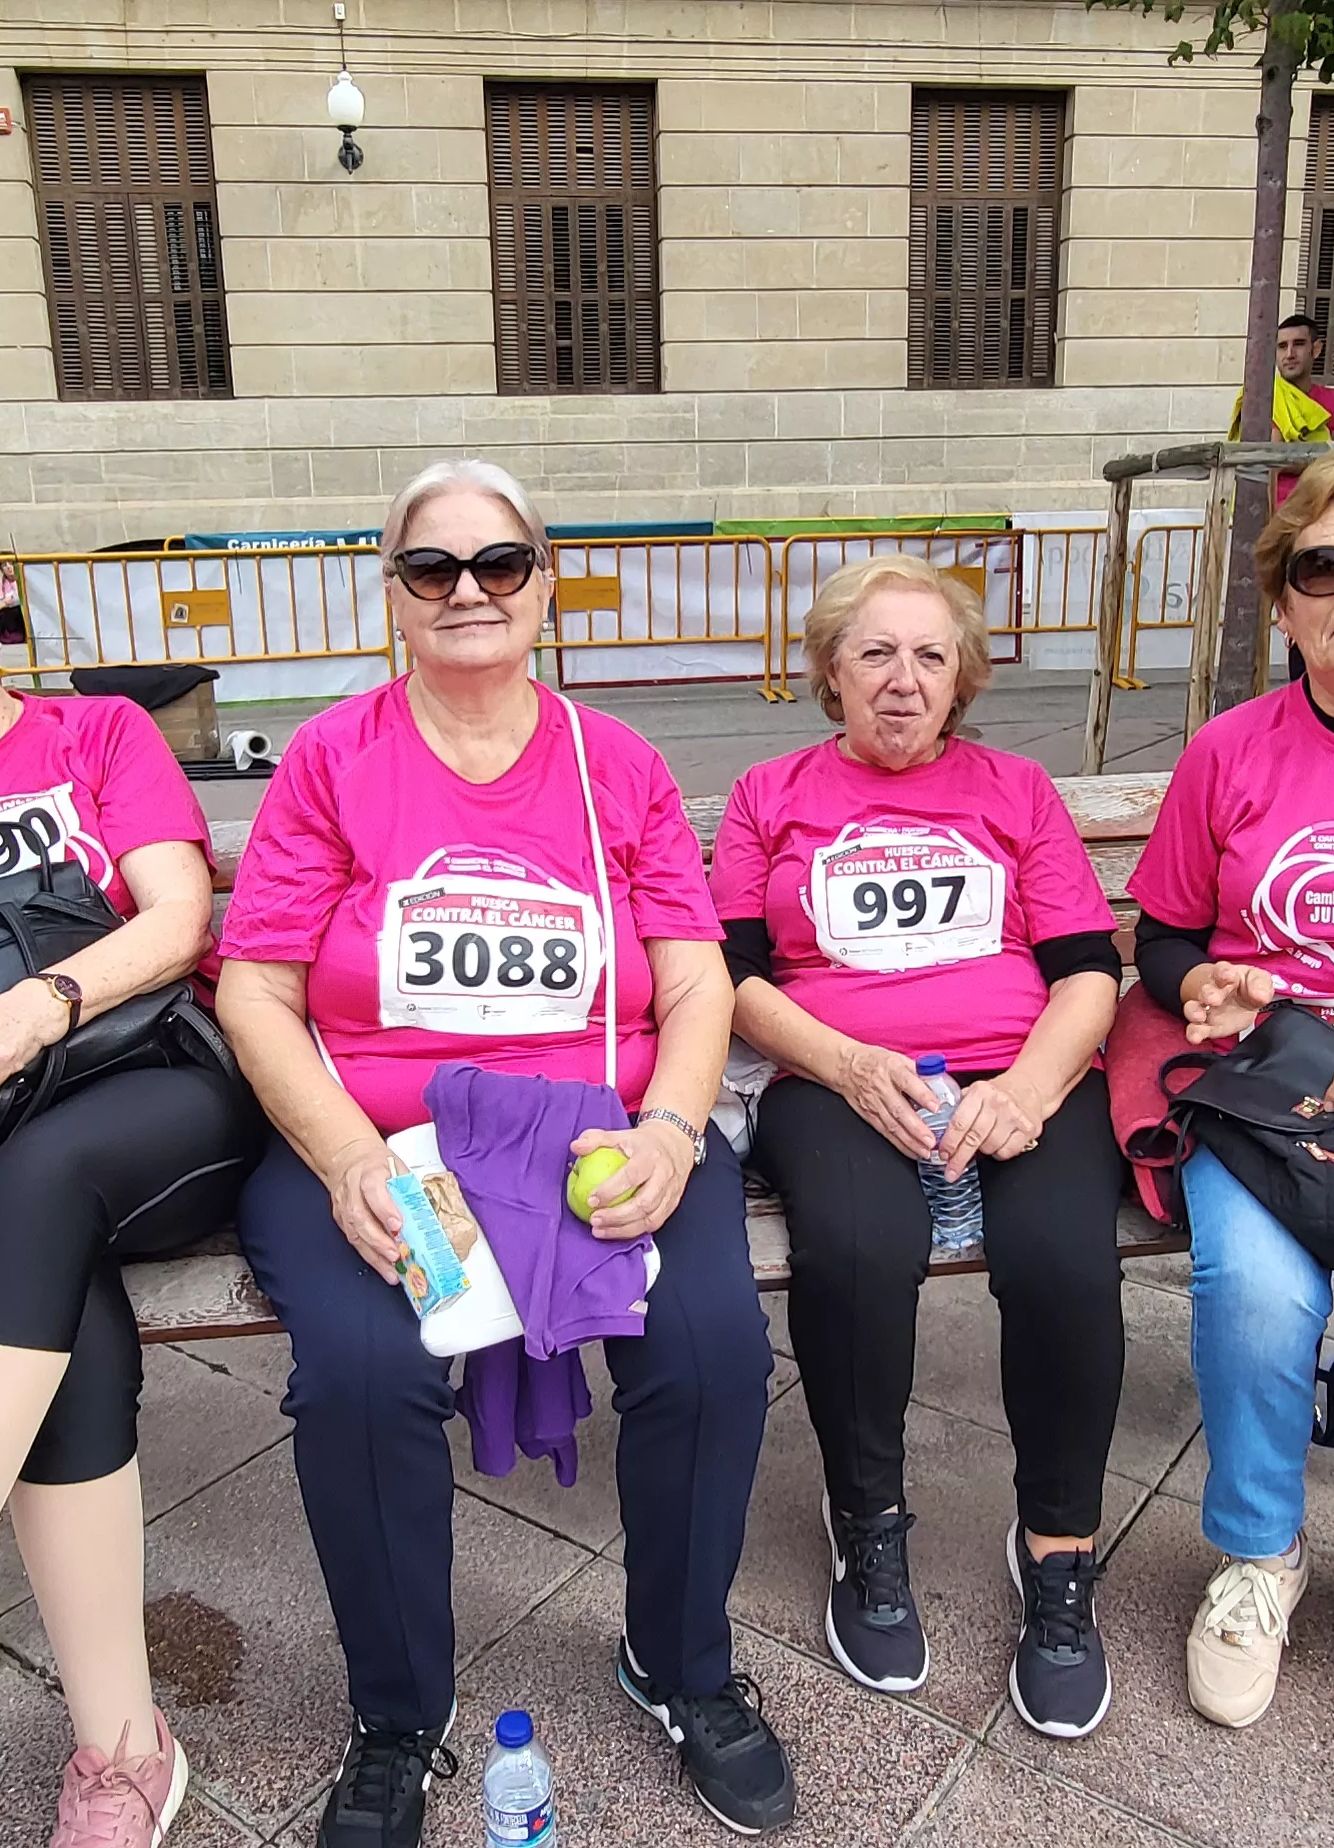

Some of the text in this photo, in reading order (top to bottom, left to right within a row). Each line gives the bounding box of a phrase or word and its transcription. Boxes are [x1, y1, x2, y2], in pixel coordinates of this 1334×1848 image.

[884, 846, 931, 858] HUESCA
[833, 859, 897, 876] CONTRA
[900, 857, 919, 871] EL
[471, 896, 519, 911] HUESCA
[853, 875, 966, 931] 997
[411, 907, 576, 931] CONTRA EL CÁNCER
[405, 931, 578, 991] 3088
